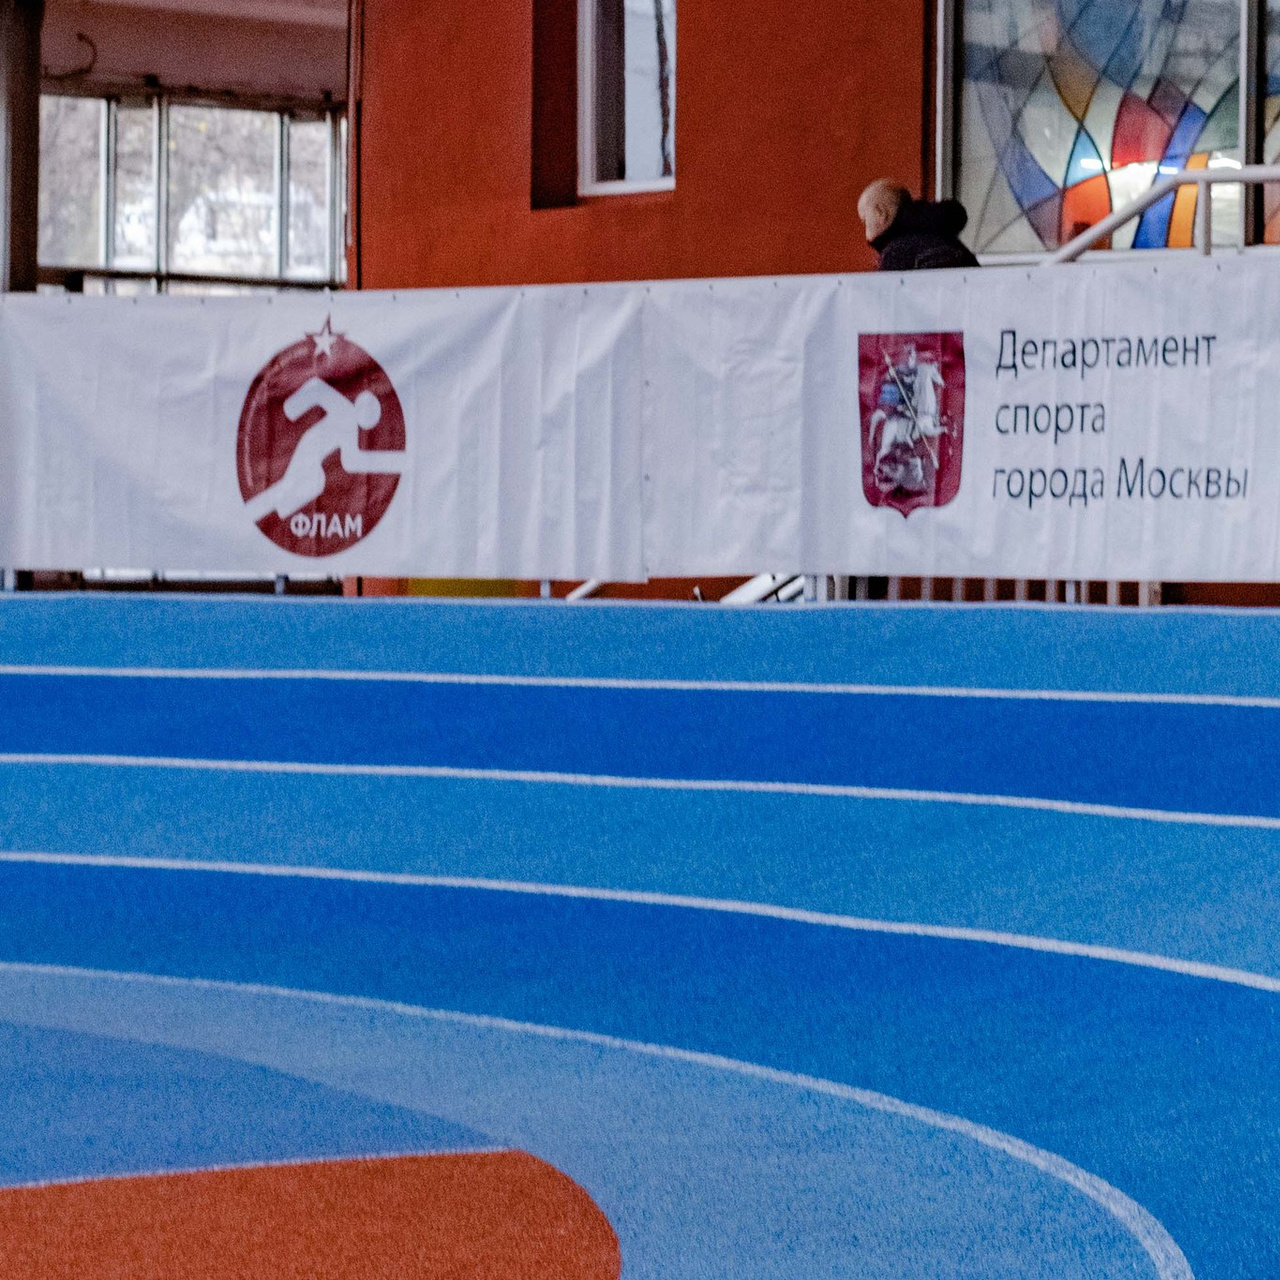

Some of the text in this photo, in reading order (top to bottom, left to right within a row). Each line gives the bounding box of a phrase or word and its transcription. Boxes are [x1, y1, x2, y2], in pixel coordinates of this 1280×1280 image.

[995, 329, 1217, 378] Департамент
[995, 401, 1107, 445] спорта
[991, 457, 1249, 508] города Москвы
[290, 513, 363, 538] ФЛАМ
